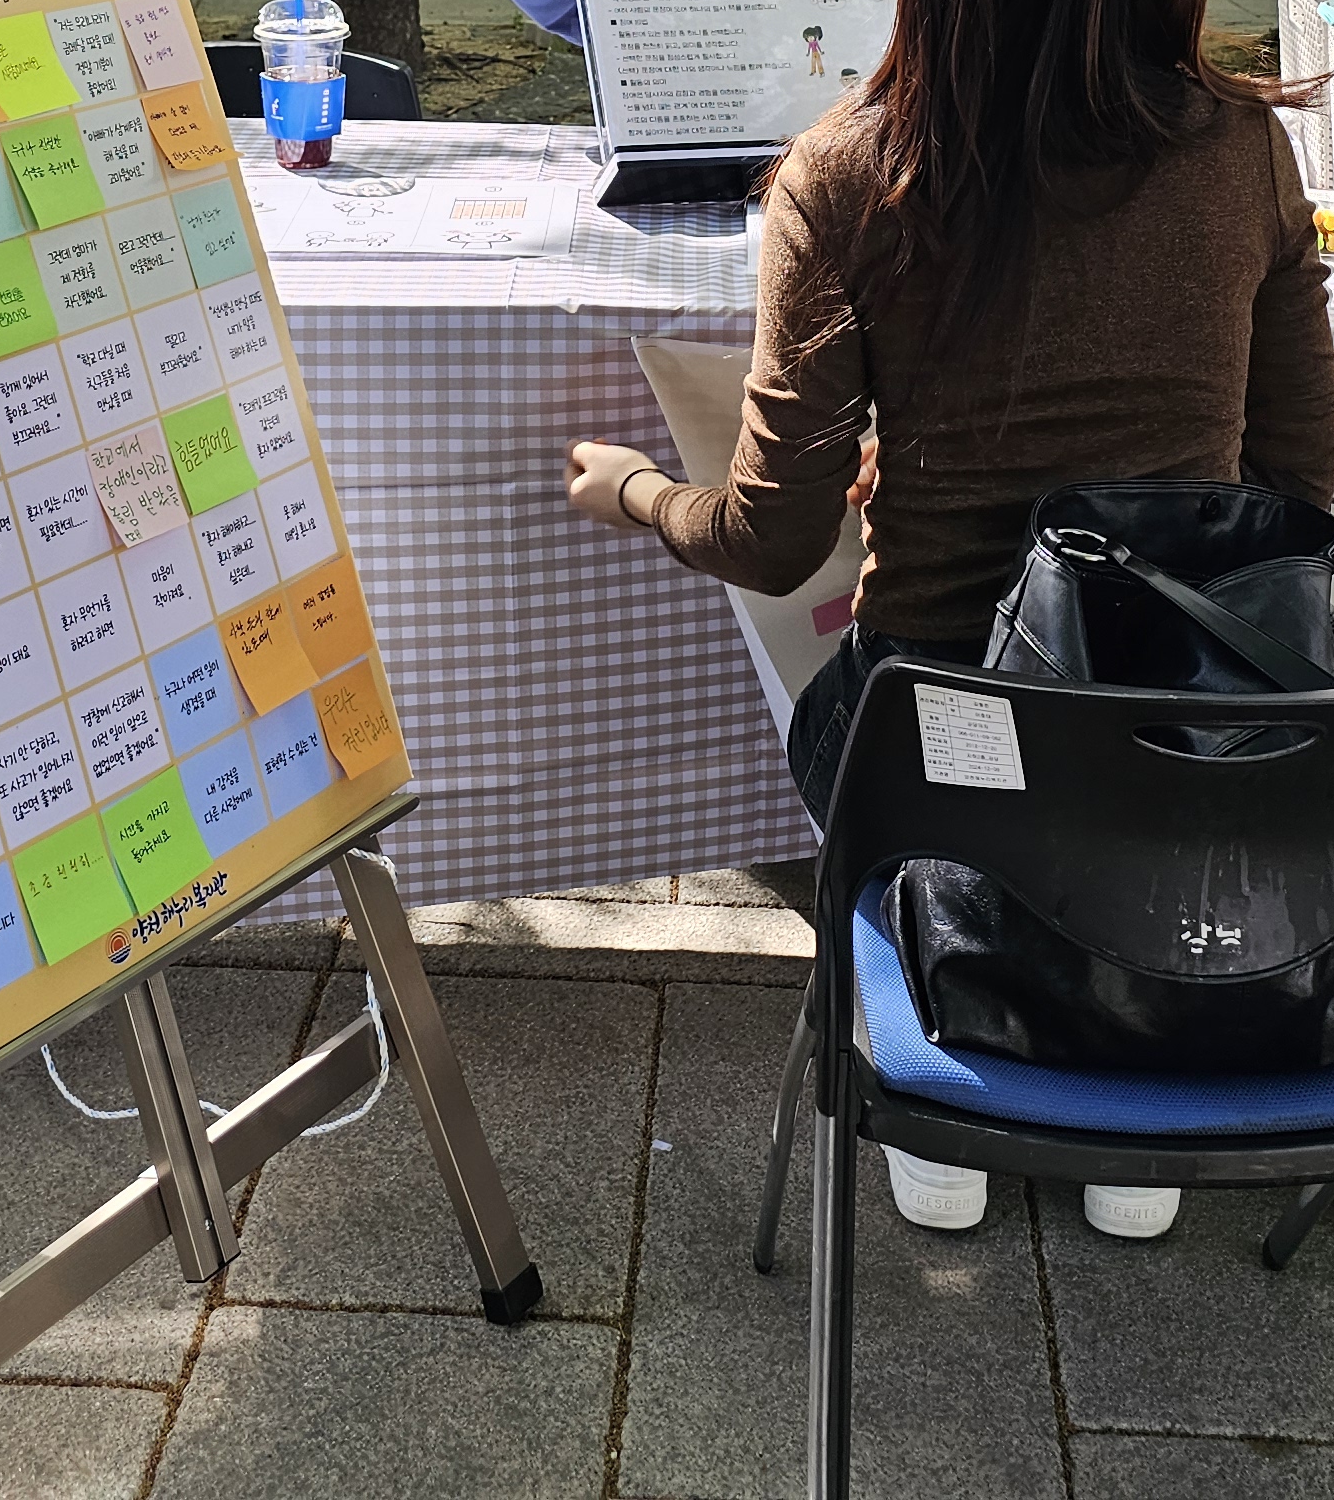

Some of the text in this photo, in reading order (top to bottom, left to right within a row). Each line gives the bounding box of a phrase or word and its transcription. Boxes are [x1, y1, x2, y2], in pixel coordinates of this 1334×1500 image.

[204, 765, 240, 797] 내 감정을
[202, 786, 254, 825] 다른 사람에게
